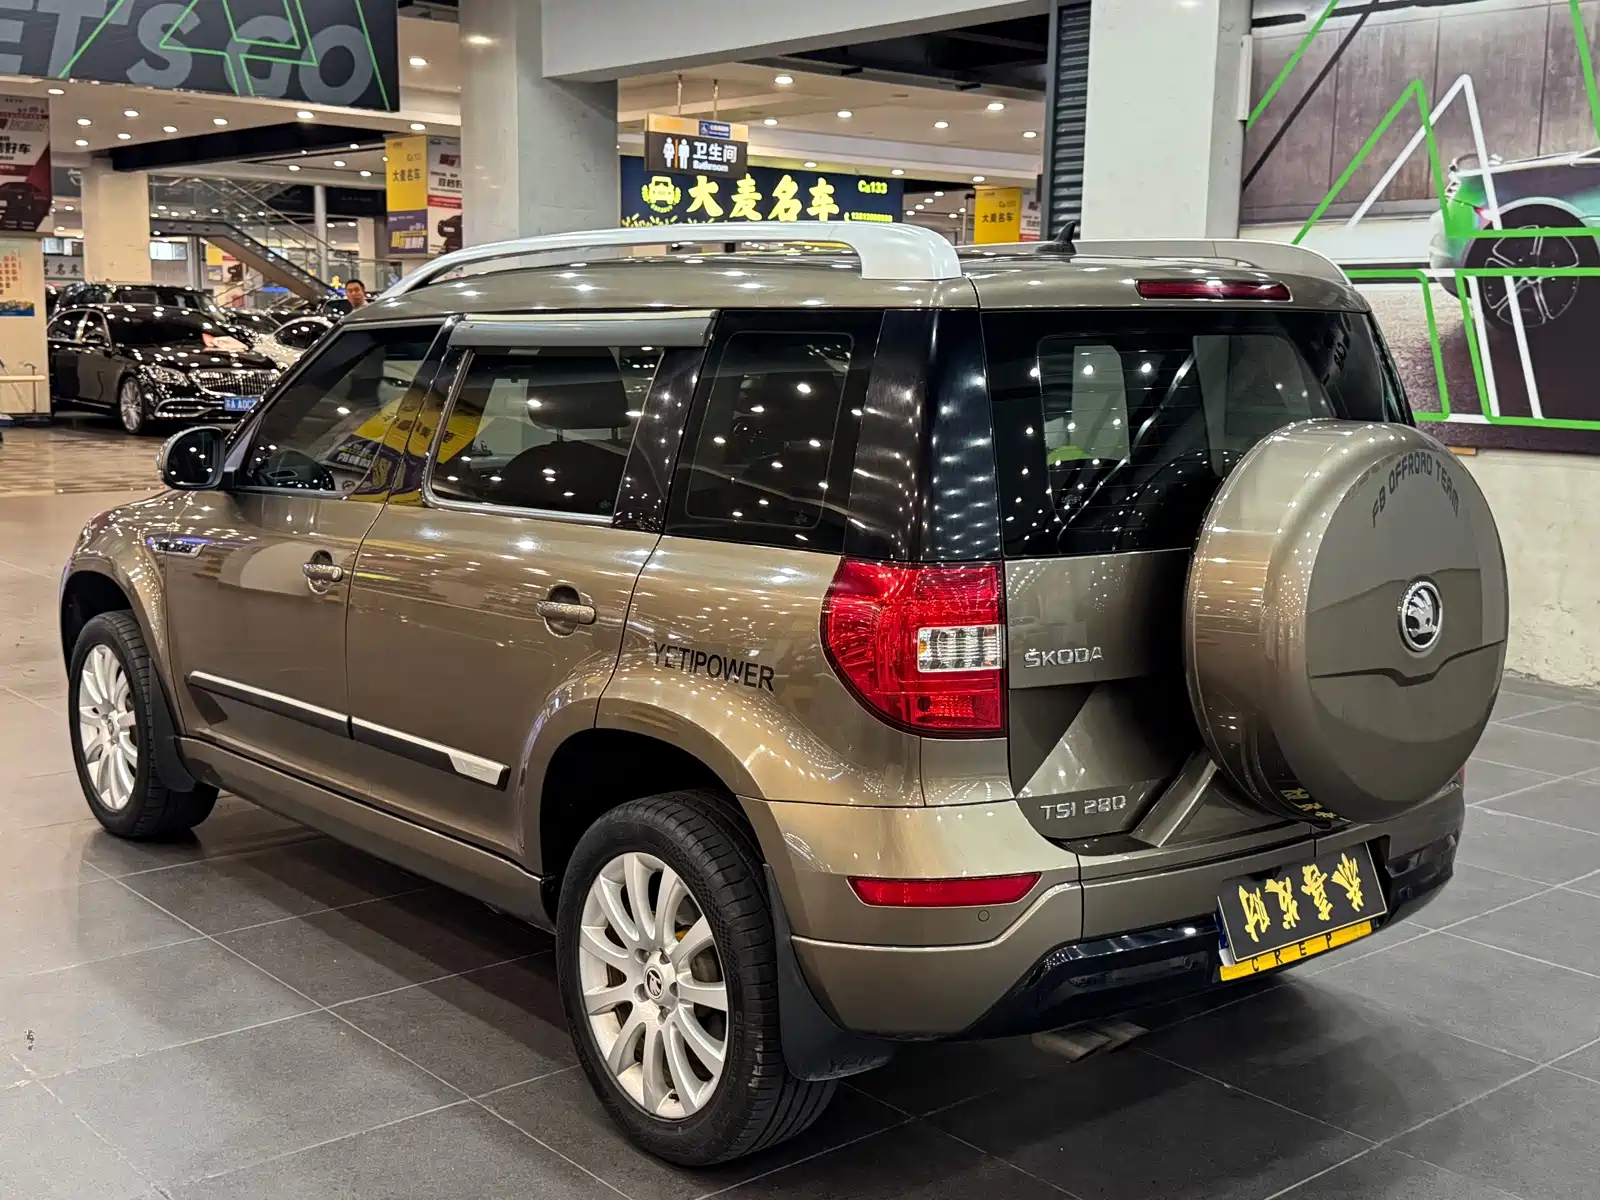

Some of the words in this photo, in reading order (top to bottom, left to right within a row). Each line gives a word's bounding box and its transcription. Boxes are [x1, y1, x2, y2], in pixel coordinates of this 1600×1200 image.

[223, 14, 374, 105] GO
[692, 141, 738, 164] 卫生间
[685, 173, 840, 222] 大麦名车
[1388, 451, 1433, 495] OFFROAD
[1435, 459, 1459, 519] TEAM
[653, 641, 775, 692] YETIPOWER
[1024, 646, 1104, 668] ŠKODA
[1040, 801, 1076, 820] TSI
[1083, 794, 1127, 815] 280
